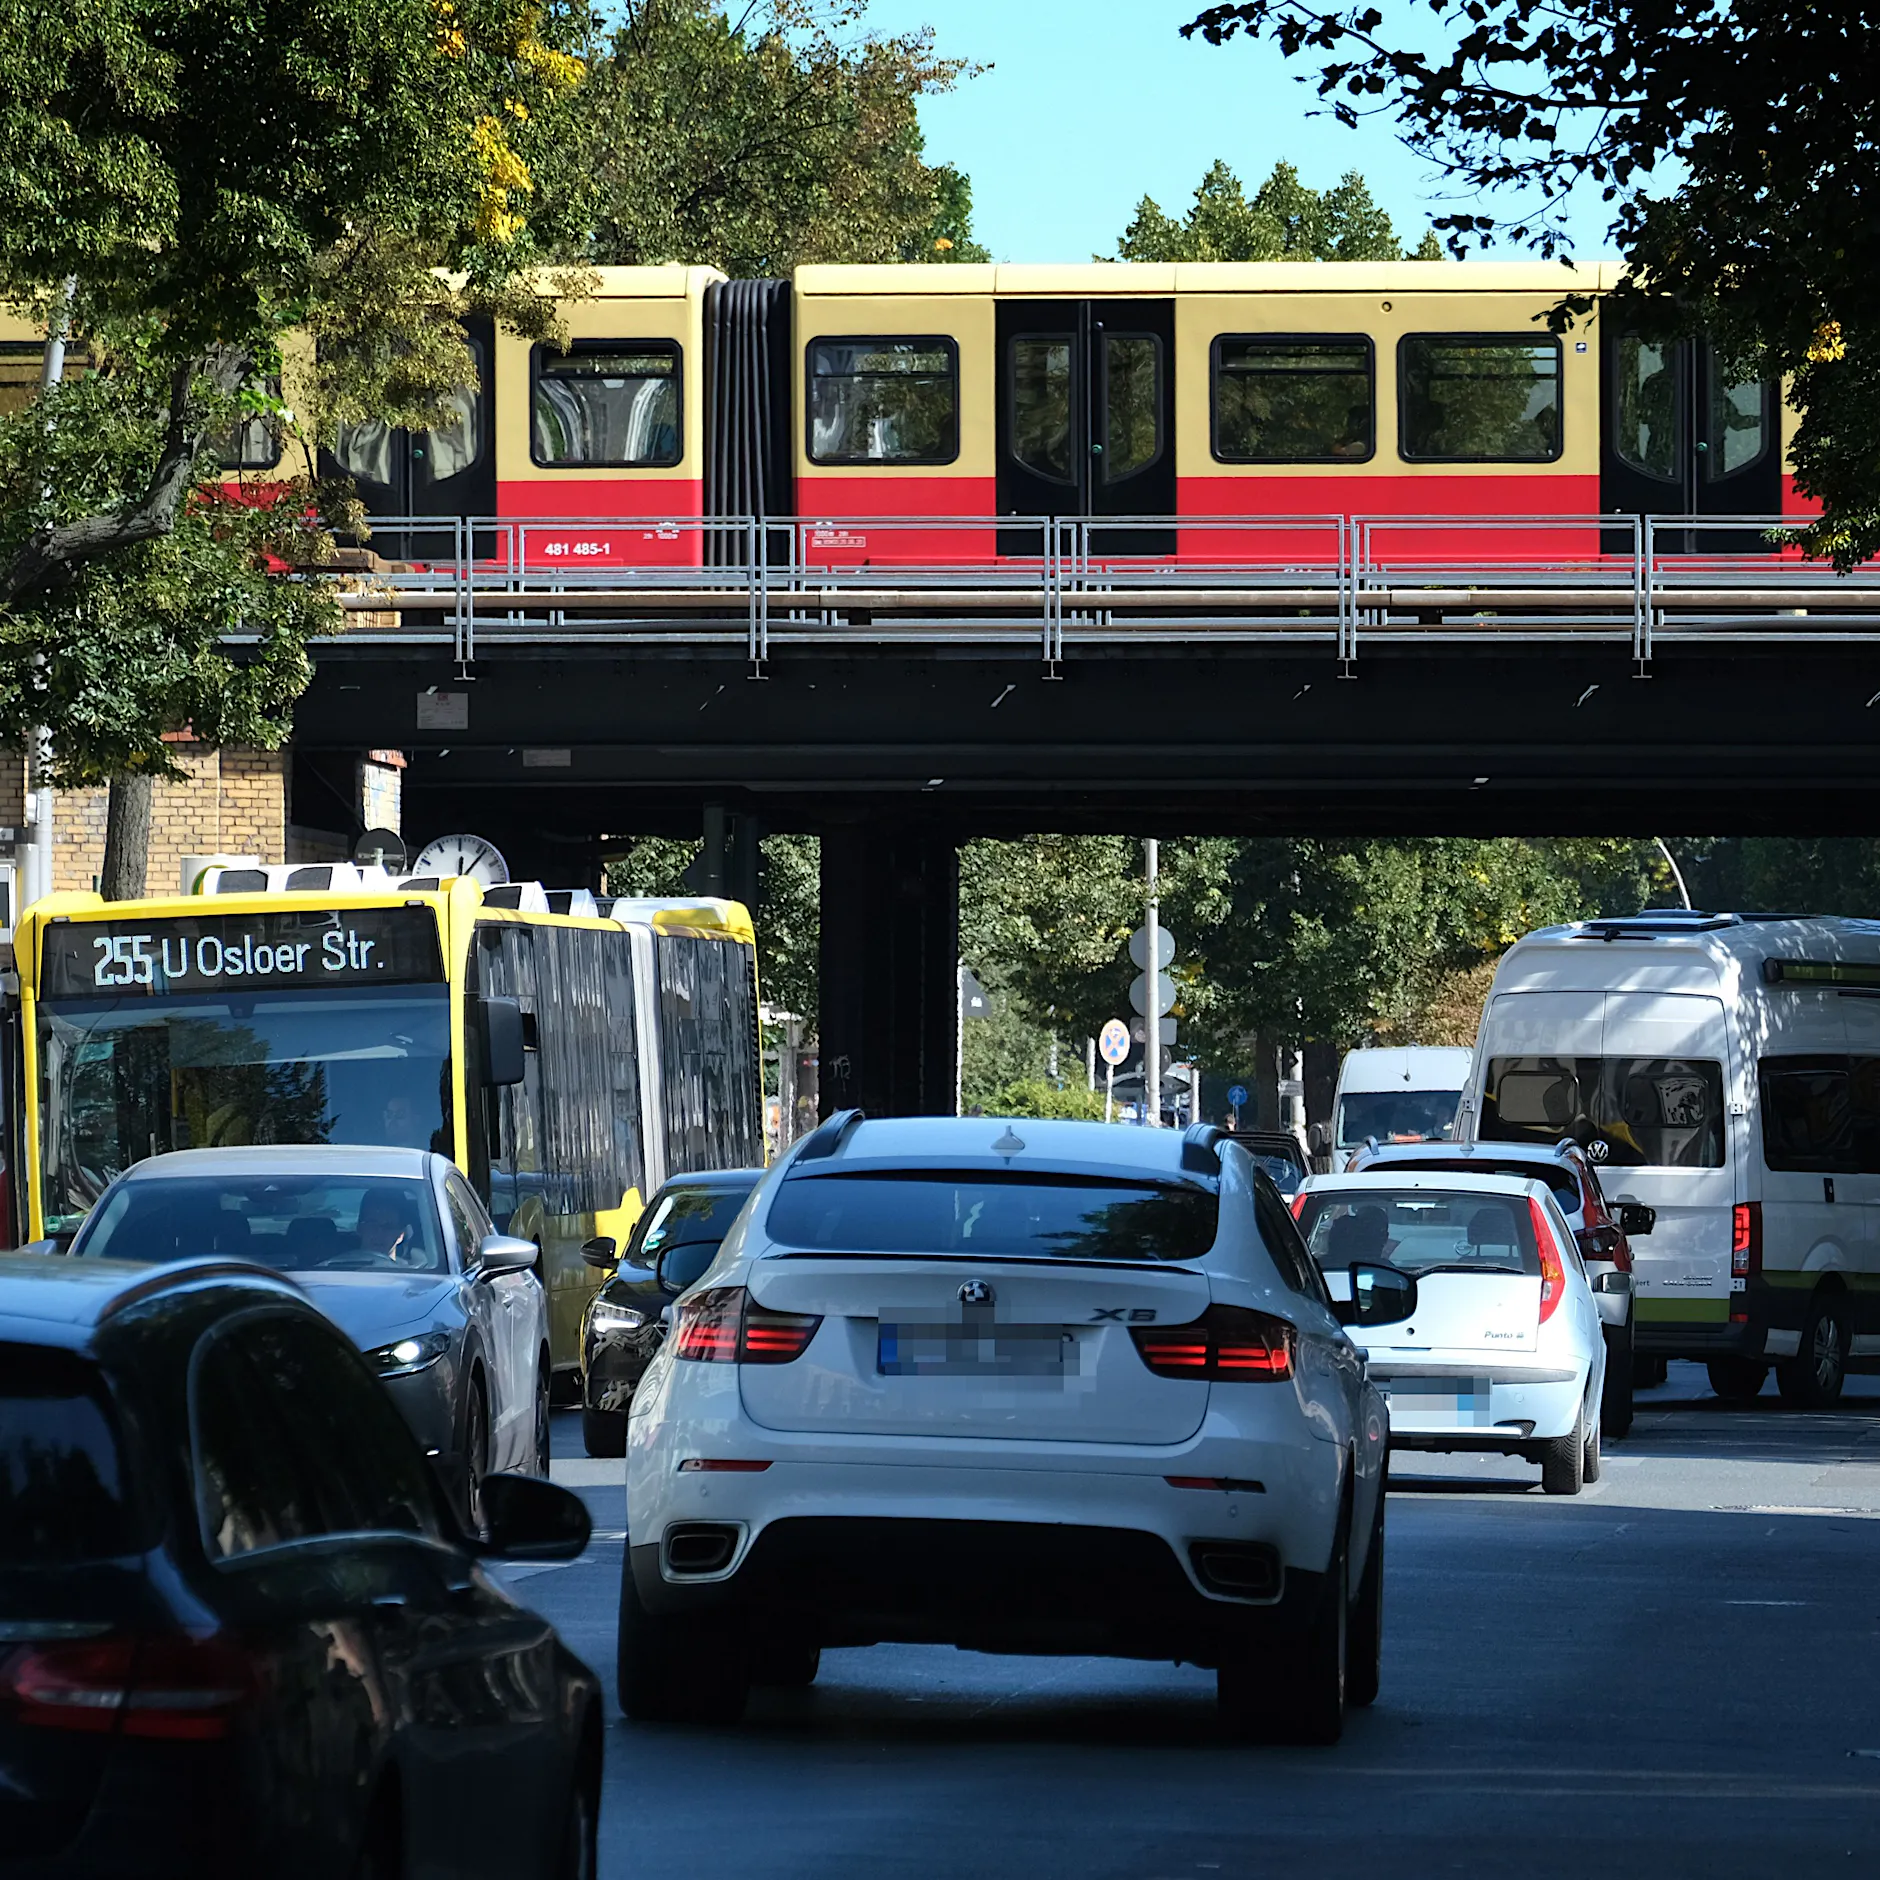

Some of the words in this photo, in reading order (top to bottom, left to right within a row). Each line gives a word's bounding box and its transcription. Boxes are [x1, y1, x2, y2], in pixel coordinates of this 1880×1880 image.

[544, 543, 570, 556] 481
[573, 543, 611, 555] 485-1
[93, 934, 152, 986] 255
[162, 937, 188, 978] U
[196, 934, 311, 977] Osloer
[321, 930, 384, 971] Str.
[1484, 1330, 1514, 1339] Punto
